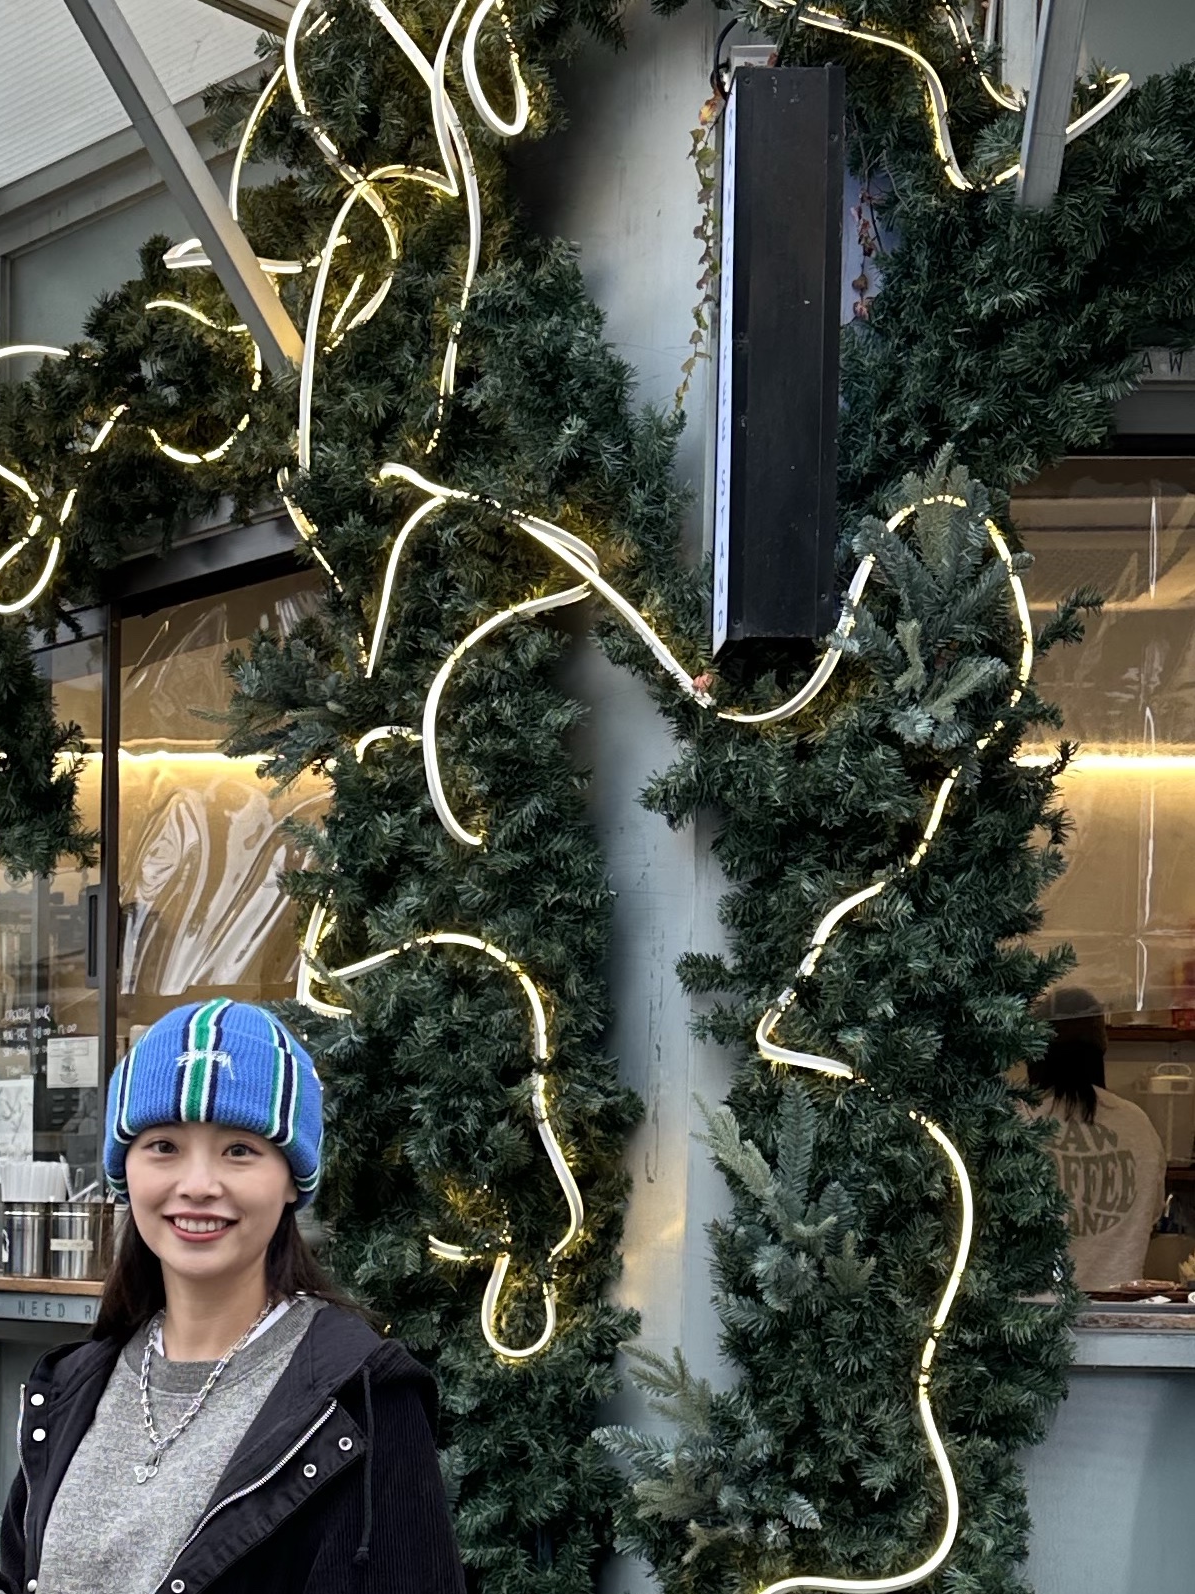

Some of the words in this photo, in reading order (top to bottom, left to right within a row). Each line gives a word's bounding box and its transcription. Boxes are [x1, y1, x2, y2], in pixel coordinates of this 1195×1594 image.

[1048, 1118, 1119, 1153] AW
[1051, 1150, 1137, 1213] FFEE
[18, 1300, 65, 1319] NEED
